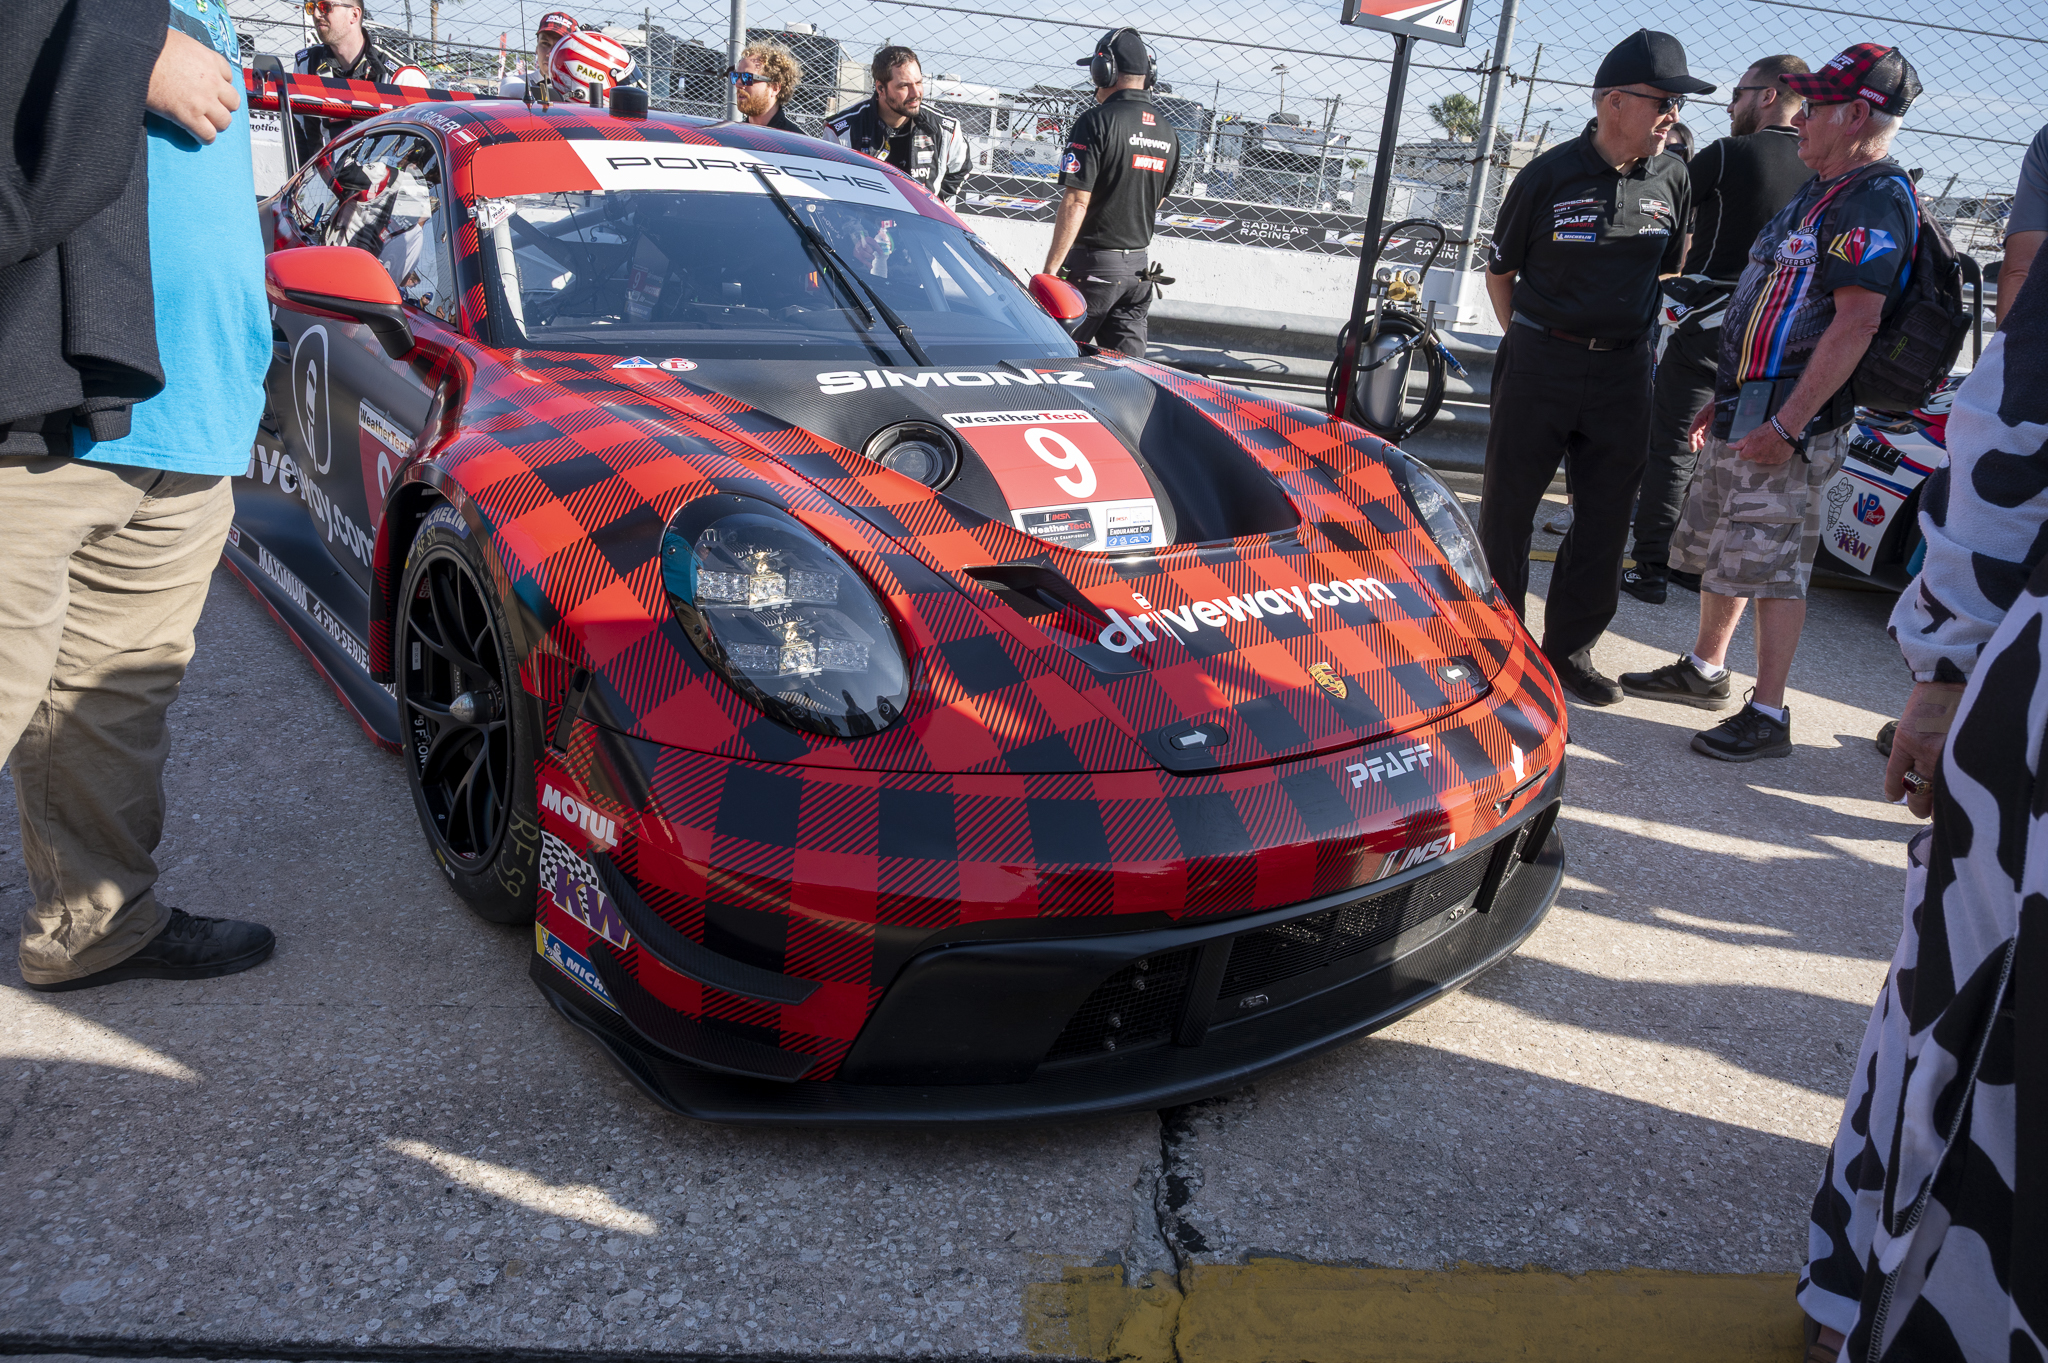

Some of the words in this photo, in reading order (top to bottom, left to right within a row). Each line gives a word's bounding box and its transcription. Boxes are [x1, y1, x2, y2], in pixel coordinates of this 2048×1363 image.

[576, 64, 605, 82] PAMO
[1859, 88, 1886, 104] MOTUL
[1129, 132, 1171, 153] driveway
[606, 157, 890, 195] PORSCHE
[1134, 157, 1164, 171] MOTUL
[1240, 228, 1291, 240] RACING
[1241, 220, 1309, 235] CADILLAC
[1554, 215, 1598, 228] PFAFF
[951, 413, 1089, 424] WeatherTech
[1852, 434, 1907, 463] GRAFF
[1024, 427, 1097, 499] 9
[1028, 521, 1091, 535] WeatherTech
[1837, 533, 1872, 561] KW
[258, 547, 308, 610] MAXIMUM
[1098, 575, 1397, 653] driveway.com
[1345, 743, 1433, 789] PFAFF
[541, 783, 619, 848] MOTUL
[1399, 832, 1456, 871] IMSA
[553, 863, 631, 951] KW
[565, 956, 609, 997] MICH
